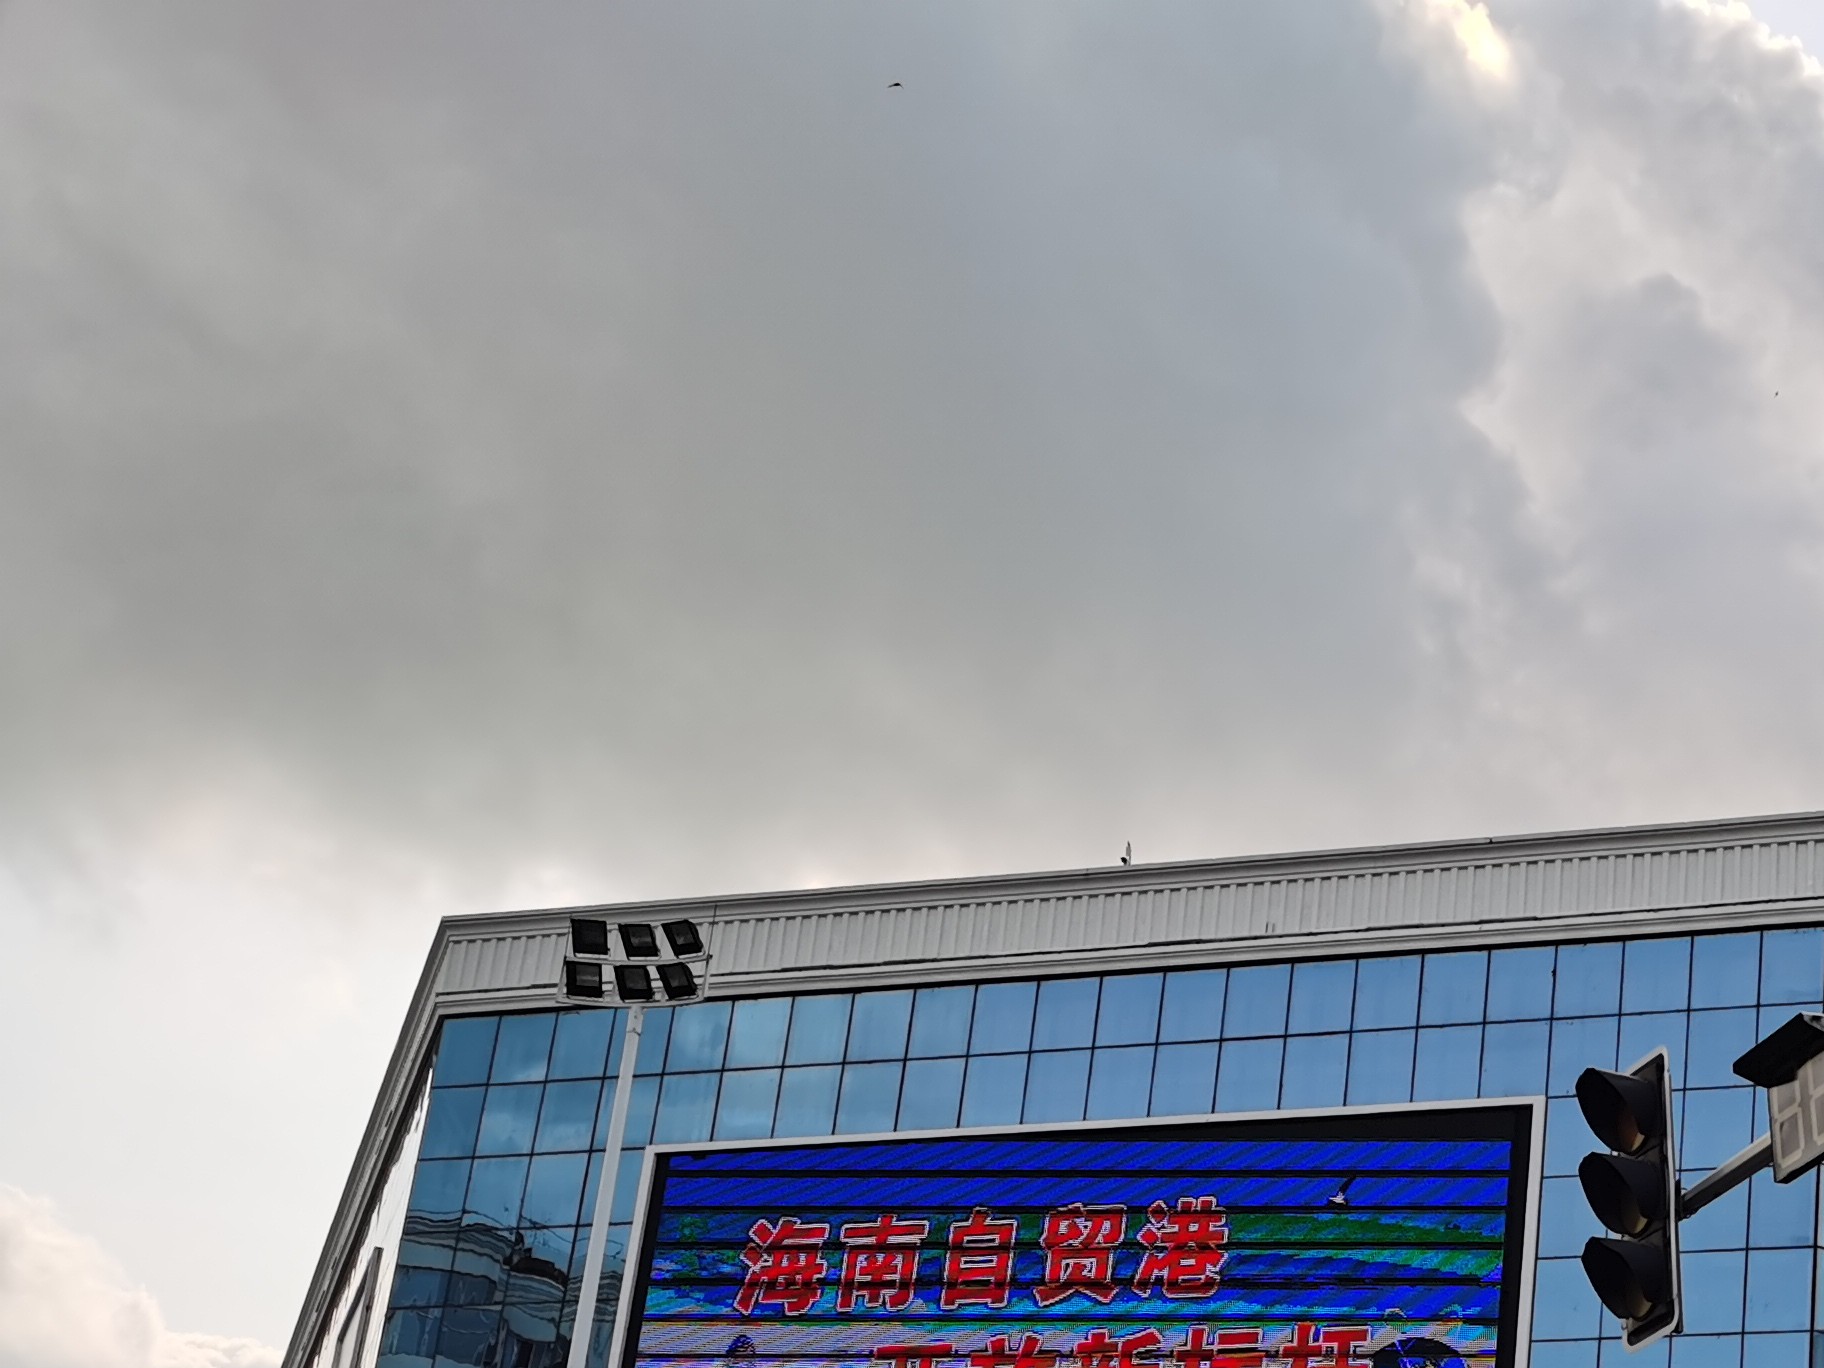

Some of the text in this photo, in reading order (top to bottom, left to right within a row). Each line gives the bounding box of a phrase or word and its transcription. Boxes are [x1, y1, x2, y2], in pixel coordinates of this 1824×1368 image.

[733, 1196, 1231, 1317] 海南自贸港
